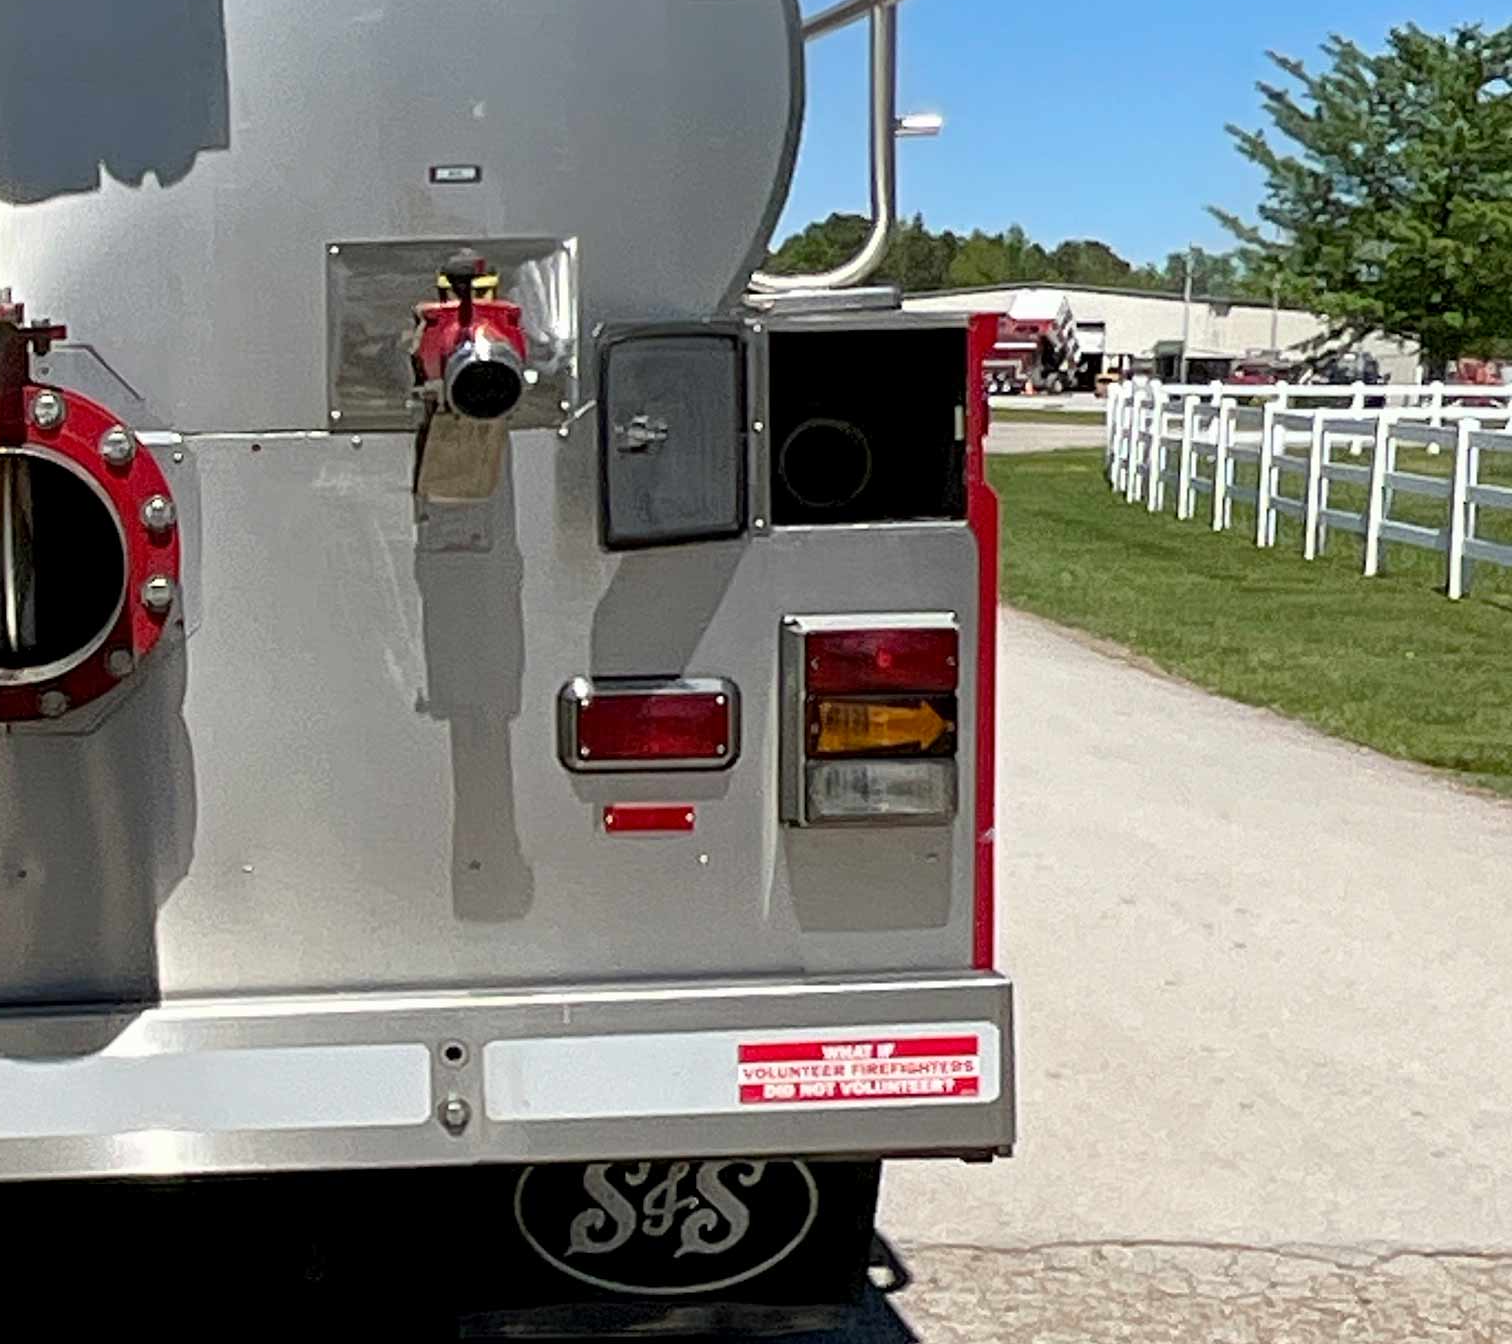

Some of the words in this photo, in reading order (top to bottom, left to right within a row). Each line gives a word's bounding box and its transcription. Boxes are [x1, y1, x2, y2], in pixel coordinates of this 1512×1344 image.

[822, 1044, 872, 1060] WHAT
[877, 1043, 896, 1058] IF
[742, 1065, 845, 1080] VOLUNTEER
[851, 1060, 975, 1077] FIREFIGHTERS
[763, 1083, 796, 1099] DID
[800, 1082, 837, 1098] NOT
